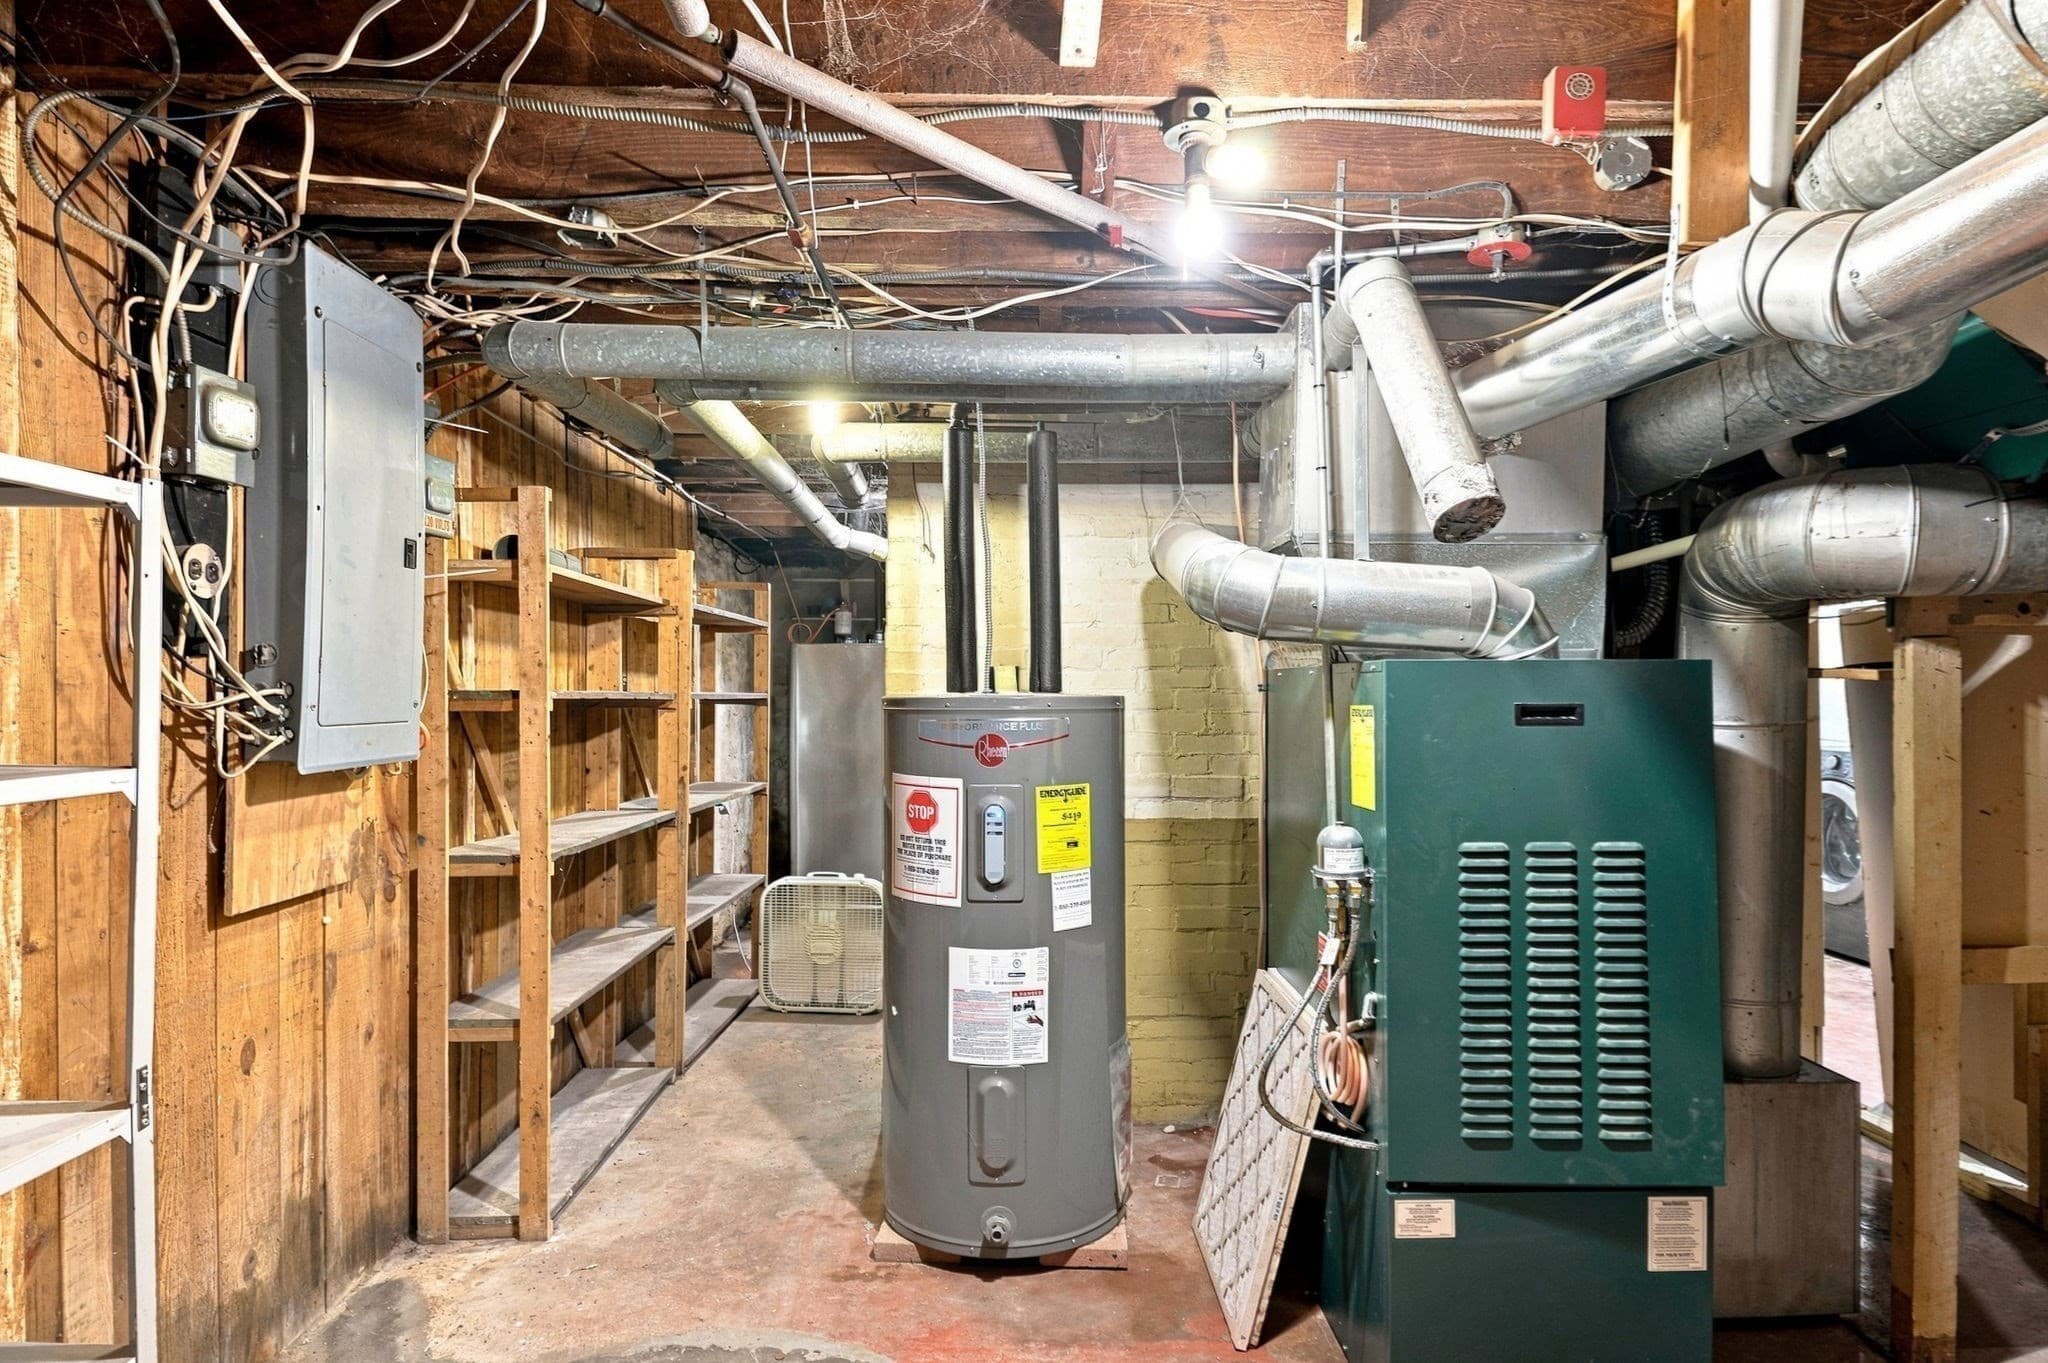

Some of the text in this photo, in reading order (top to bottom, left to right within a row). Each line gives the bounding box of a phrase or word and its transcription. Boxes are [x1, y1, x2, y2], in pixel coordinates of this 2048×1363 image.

[978, 734, 1008, 762] Rheem
[908, 804, 934, 820] STOP
[924, 853, 952, 861] PURCHASE
